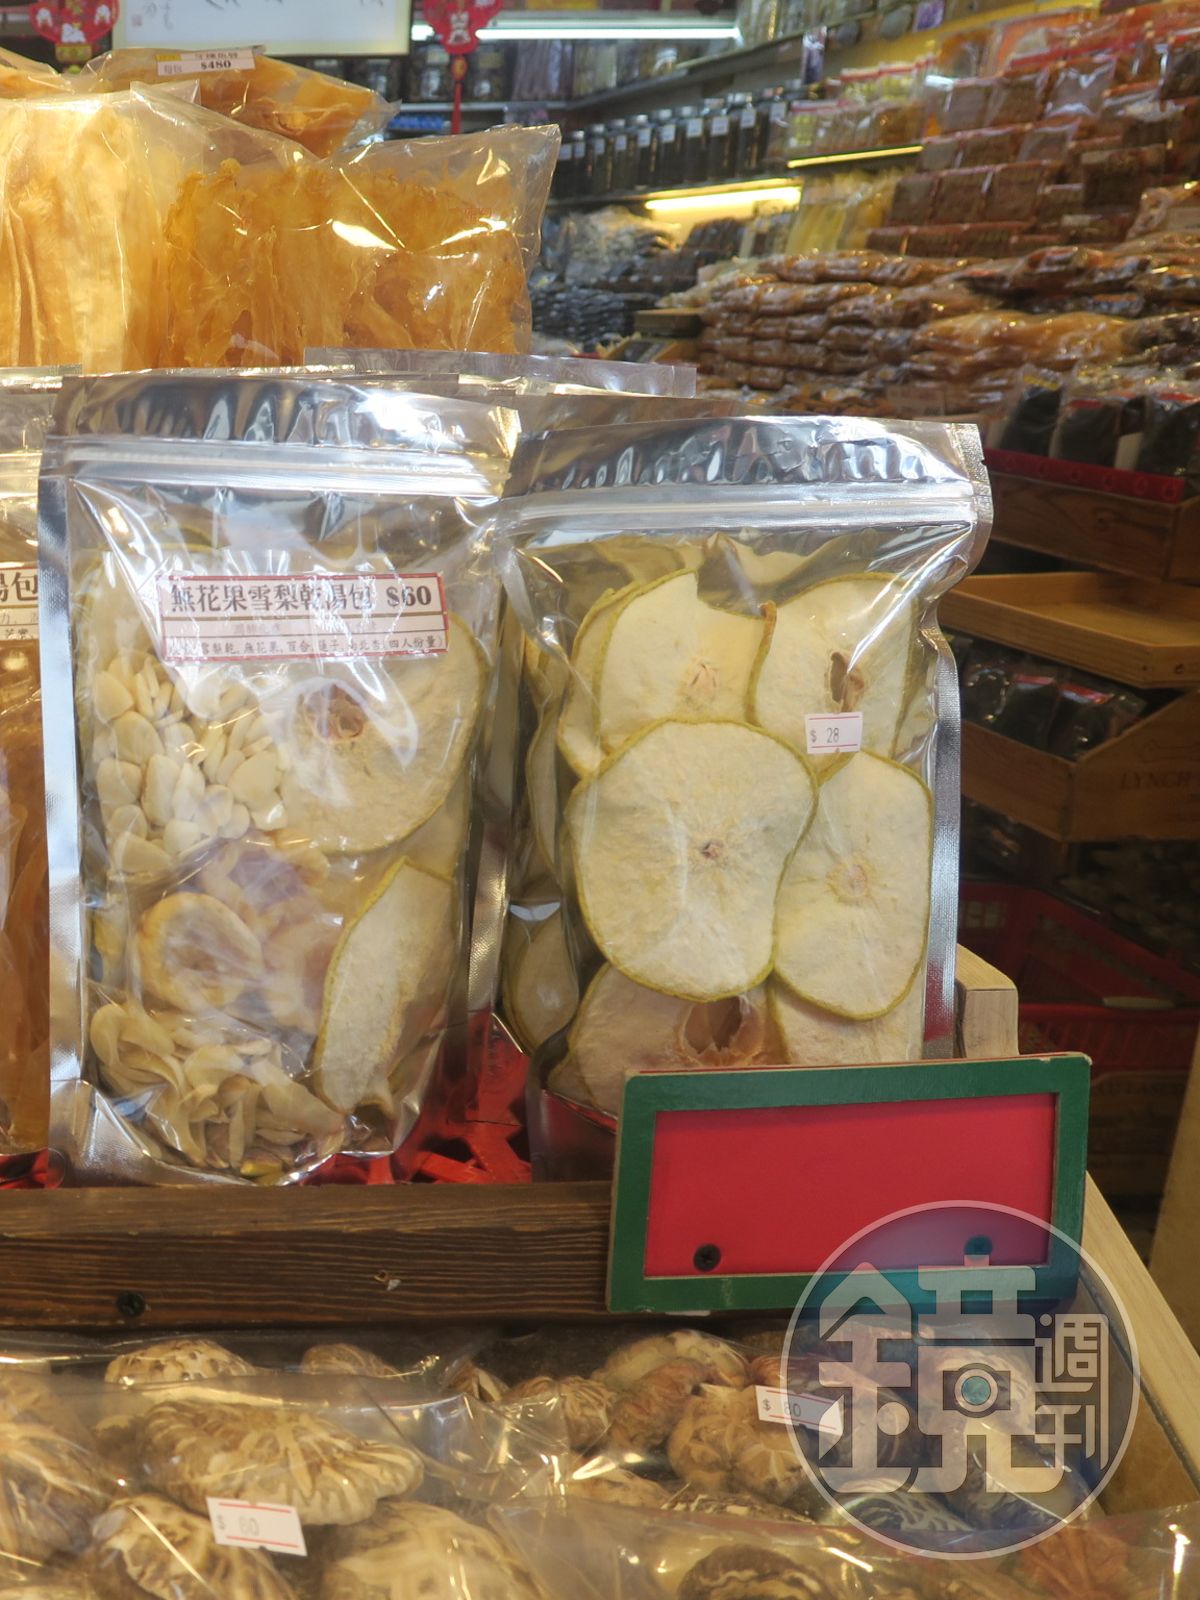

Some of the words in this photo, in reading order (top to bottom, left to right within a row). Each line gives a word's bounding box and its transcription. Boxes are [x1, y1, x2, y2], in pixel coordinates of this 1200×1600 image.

[200, 60, 232, 70] $480
[385, 585, 432, 608] $60
[825, 726, 840, 744] 28
